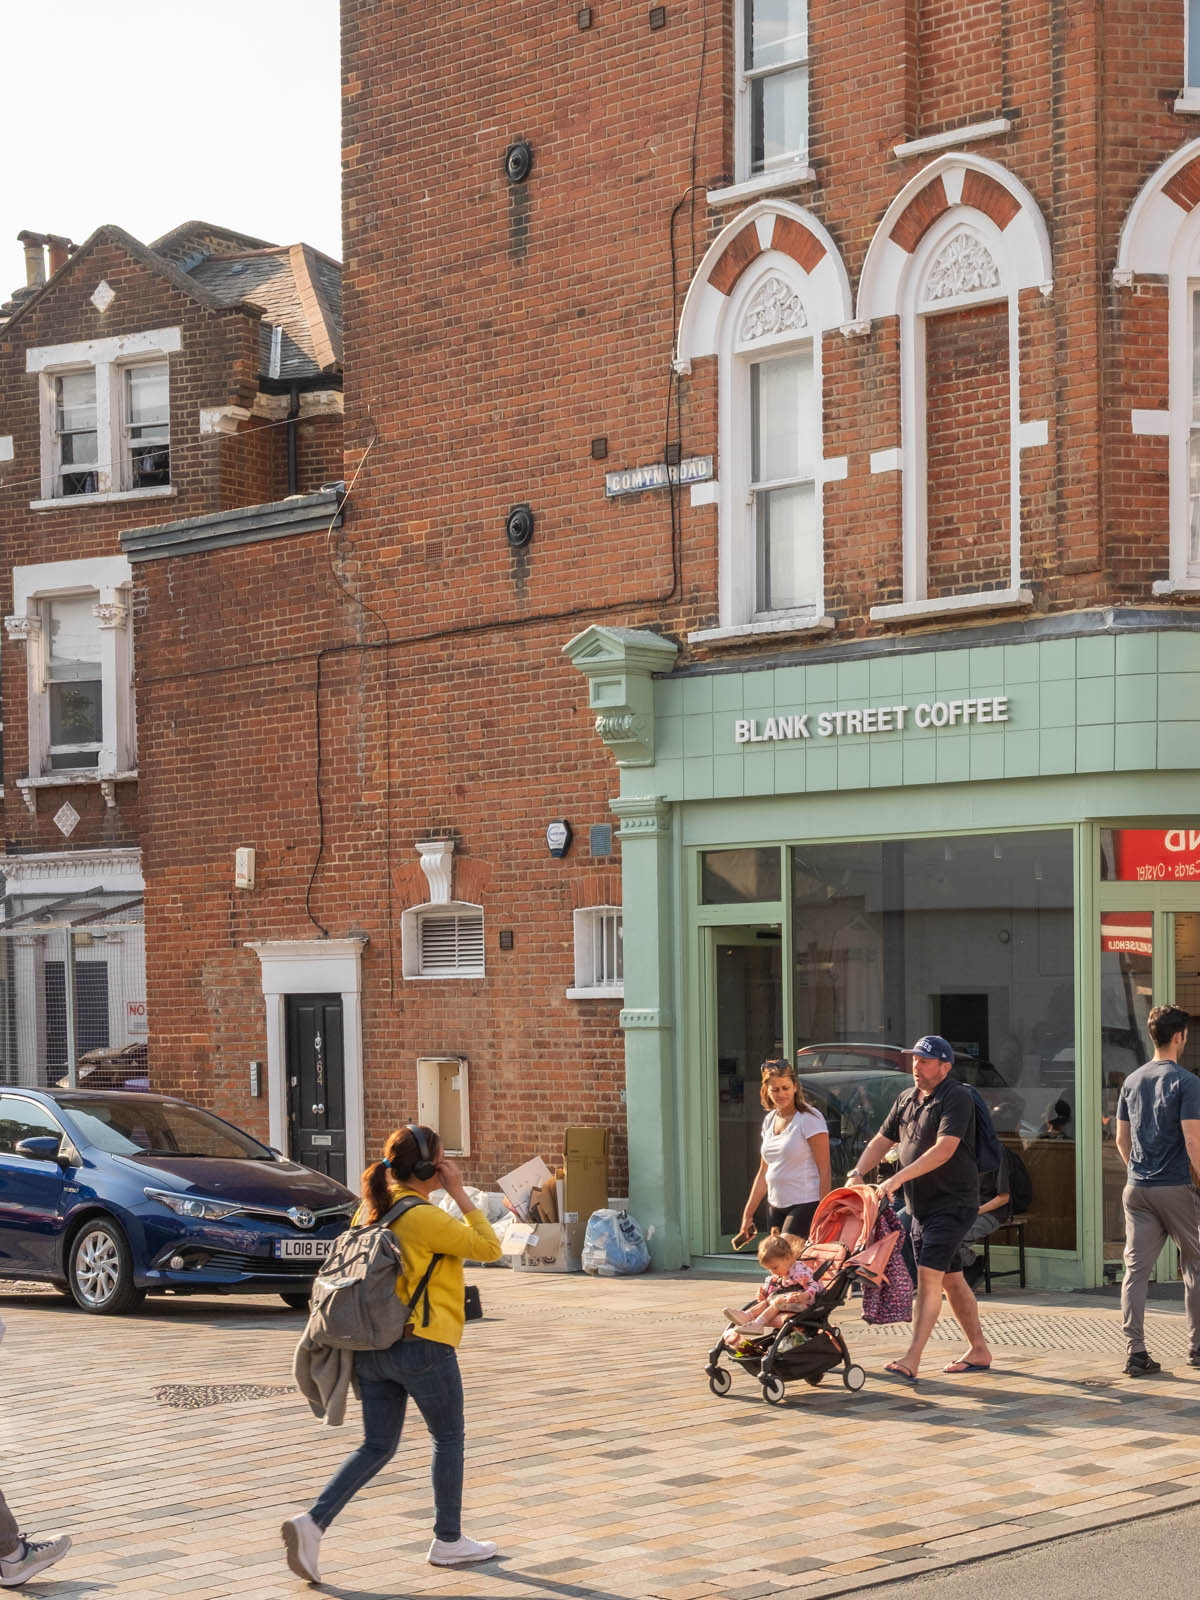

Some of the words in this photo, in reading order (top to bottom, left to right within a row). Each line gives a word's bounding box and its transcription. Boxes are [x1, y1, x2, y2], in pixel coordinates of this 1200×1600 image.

[611, 468, 663, 491] COMYN
[668, 461, 707, 481] ROAD
[735, 714, 810, 743] BLANK
[817, 705, 909, 736] STREET
[914, 696, 1009, 728] COFFEE
[129, 1004, 145, 1016] NO
[285, 1242, 313, 1256] LO18
